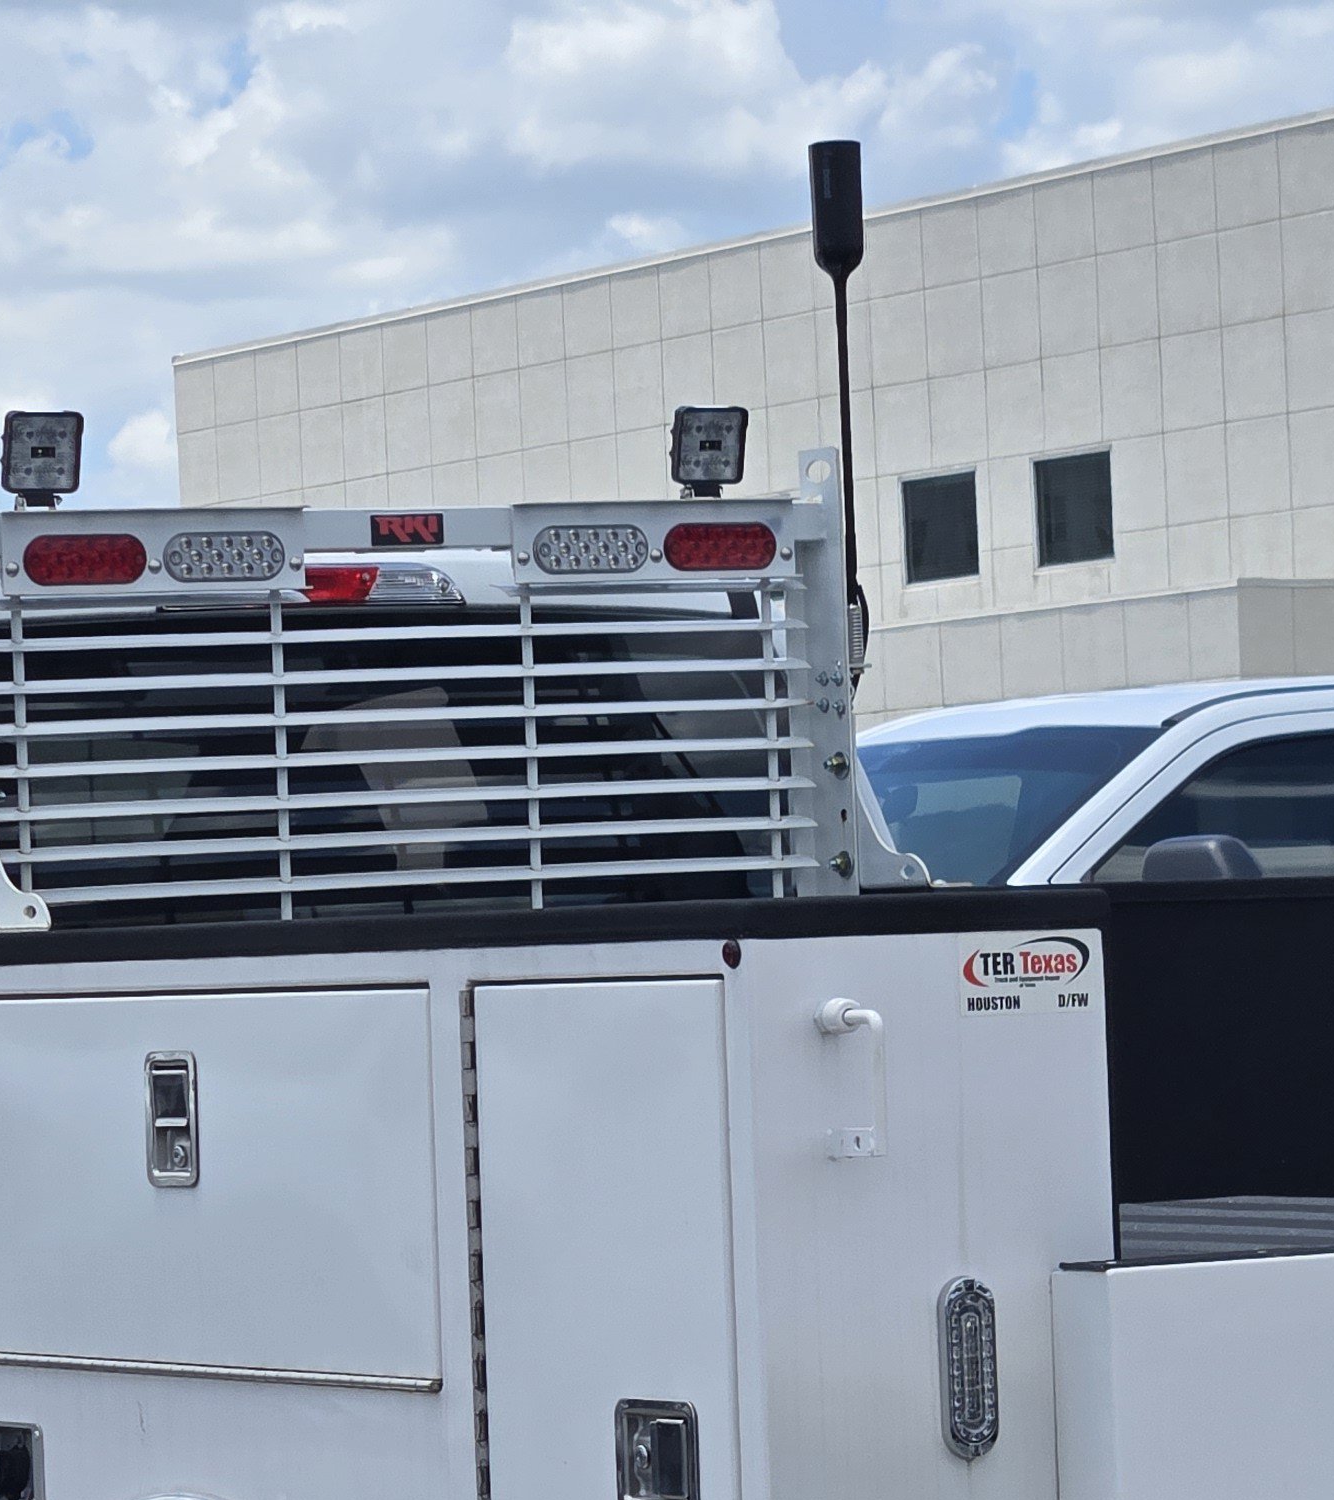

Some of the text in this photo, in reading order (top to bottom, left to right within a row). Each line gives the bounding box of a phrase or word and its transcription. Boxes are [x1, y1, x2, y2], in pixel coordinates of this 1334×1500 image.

[374, 515, 438, 543] RKI
[979, 951, 1078, 976] TER Texas
[967, 995, 1021, 1011] HOUSTON
[1058, 993, 1089, 1008] D/FW
